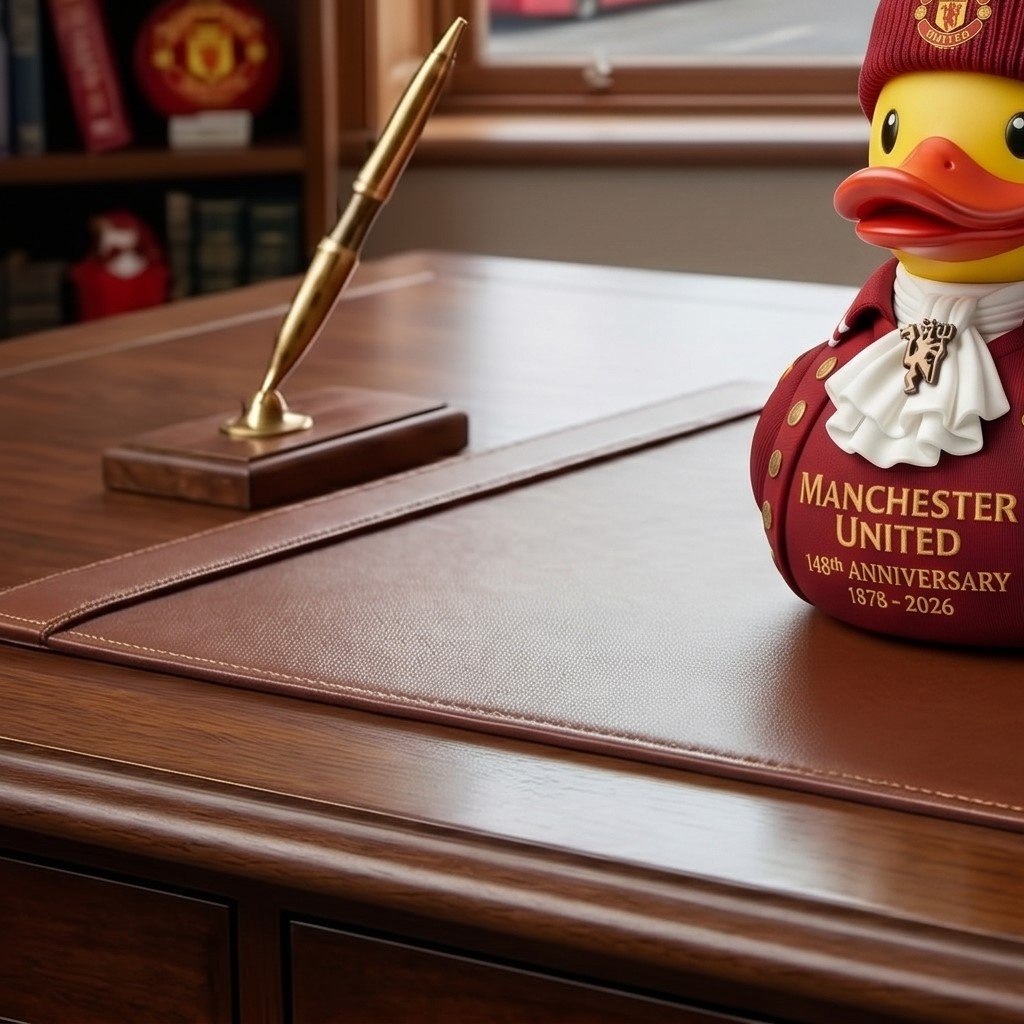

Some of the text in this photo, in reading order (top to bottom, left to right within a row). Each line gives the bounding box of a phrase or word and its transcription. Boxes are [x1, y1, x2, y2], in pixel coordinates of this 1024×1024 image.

[799, 471, 1019, 524] MANCHESTER
[836, 514, 962, 557] UNITED
[805, 553, 1012, 593] 148th ANNIVERSARY
[848, 587, 888, 609] 1878
[905, 595, 955, 616] 2026
